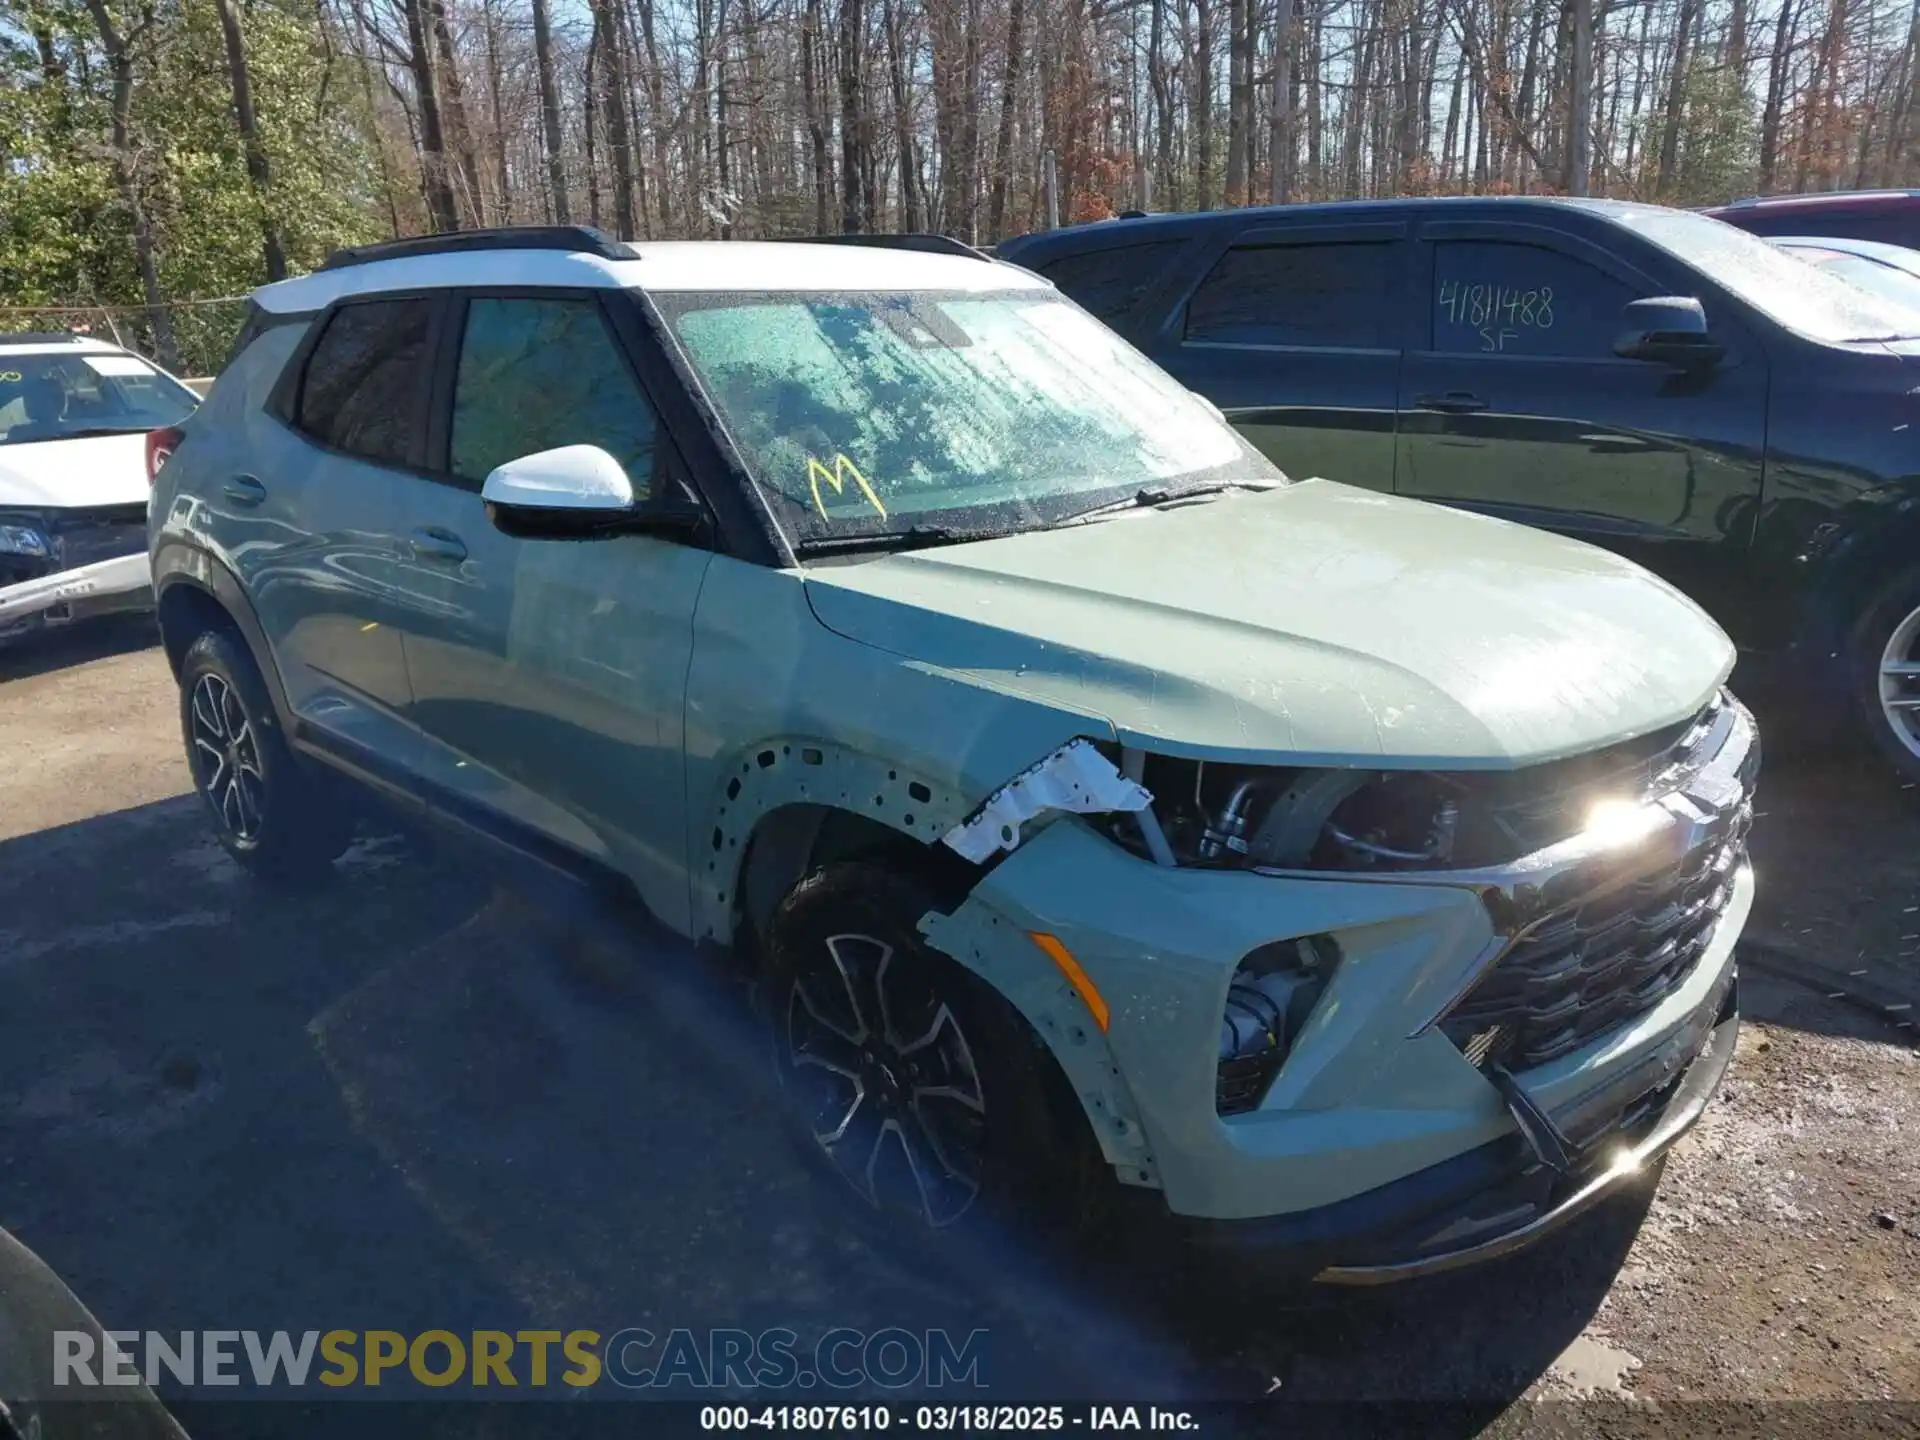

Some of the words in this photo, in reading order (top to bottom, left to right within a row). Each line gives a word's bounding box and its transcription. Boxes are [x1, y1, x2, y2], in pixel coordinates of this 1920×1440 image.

[1439, 280, 1554, 328] 41811488
[1479, 327, 1518, 351] SF
[807, 453, 888, 523] M
